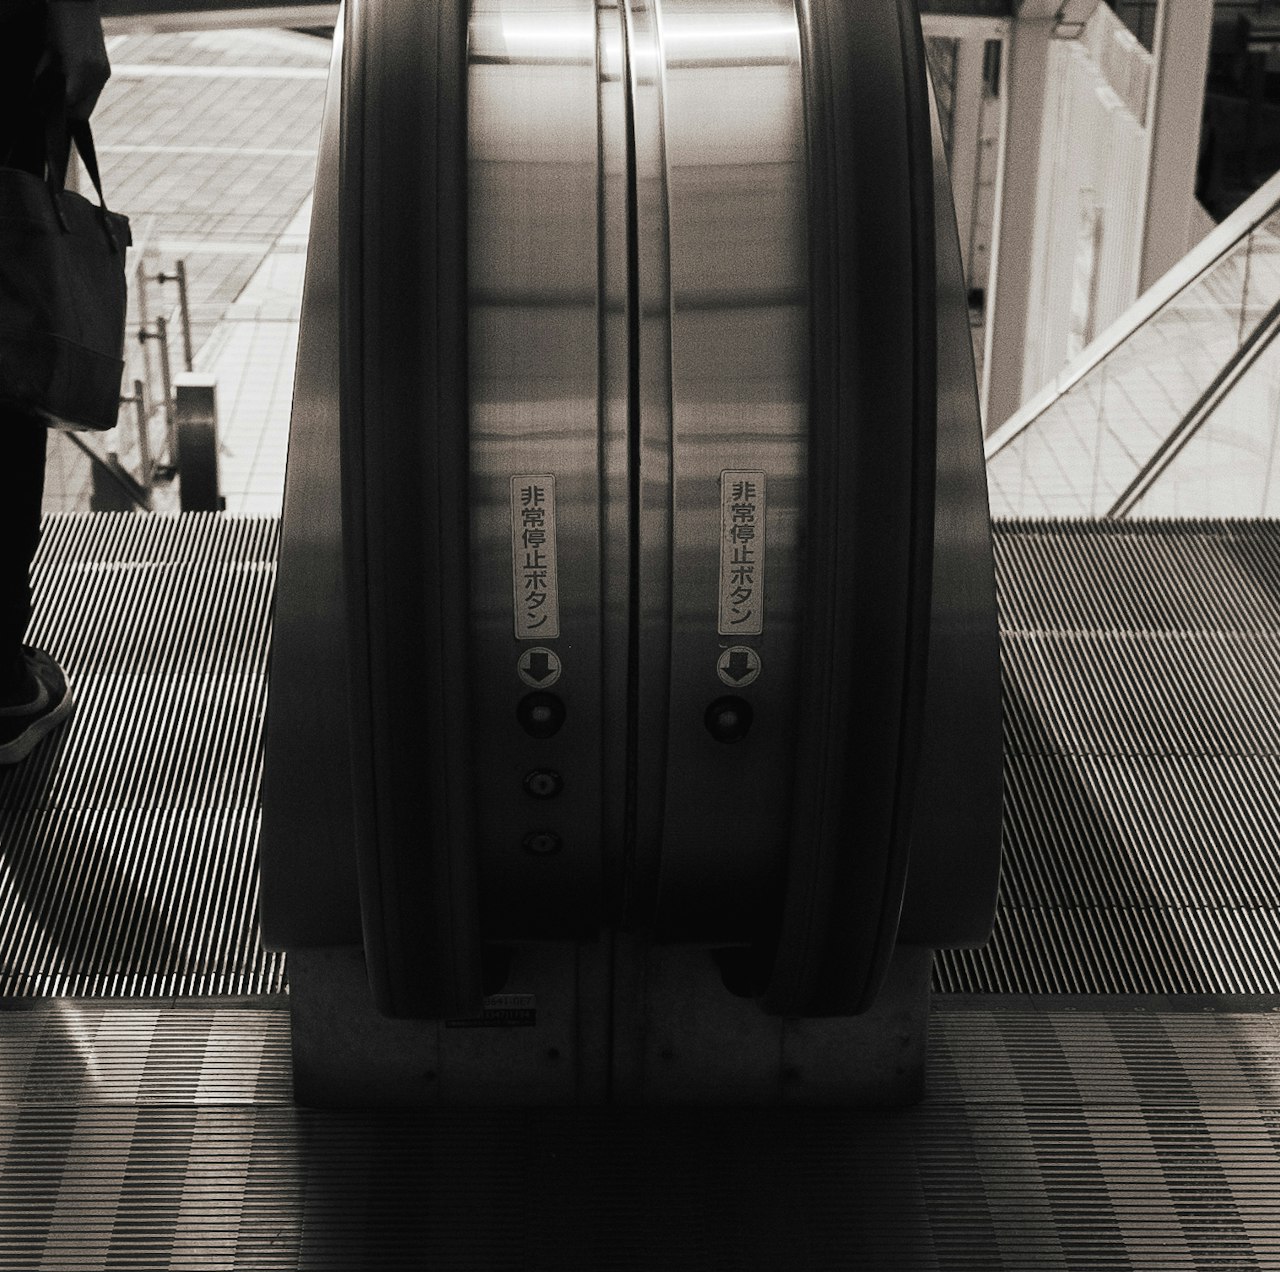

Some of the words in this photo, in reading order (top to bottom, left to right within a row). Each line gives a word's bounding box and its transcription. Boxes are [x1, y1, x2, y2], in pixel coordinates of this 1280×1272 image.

[521, 486, 548, 629] 非常停止ボタン
[730, 481, 755, 625] 非常停止ボタン
